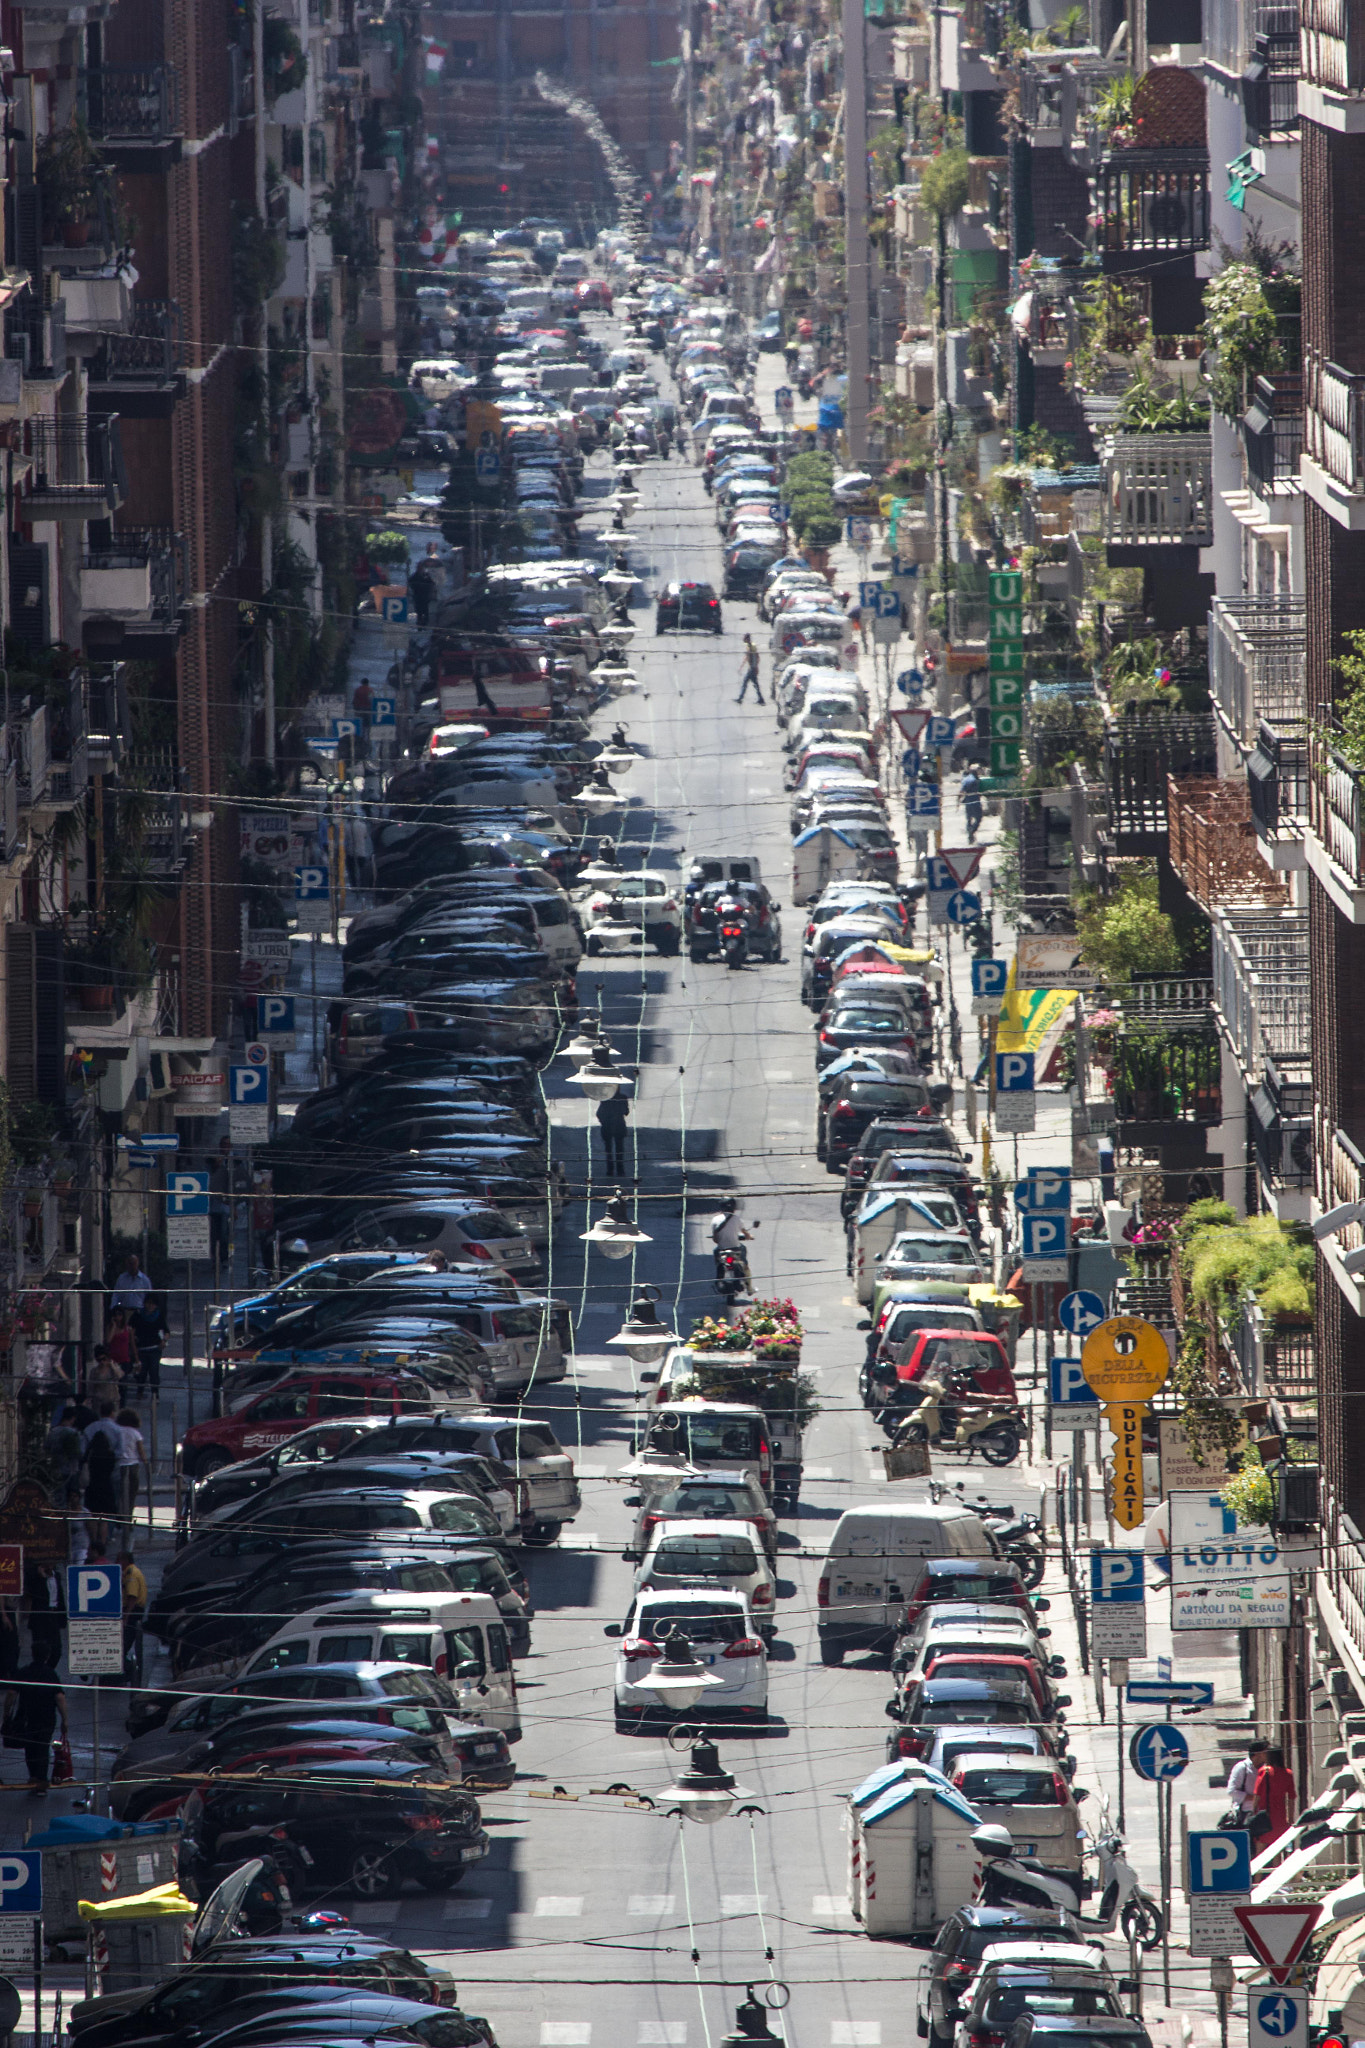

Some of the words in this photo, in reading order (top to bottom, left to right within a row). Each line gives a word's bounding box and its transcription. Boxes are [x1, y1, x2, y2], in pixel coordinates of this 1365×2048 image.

[387, 599, 403, 621] P
[864, 584, 877, 607] P
[878, 593, 896, 615] P
[994, 577, 1019, 771] UNIPOL
[377, 701, 391, 723] P
[932, 719, 950, 742] P
[915, 787, 933, 812] P
[301, 869, 324, 897] P
[259, 944, 289, 956] LIBRI
[978, 964, 1001, 993] P
[264, 998, 287, 1028] P
[235, 1069, 261, 1101] P
[1002, 1055, 1028, 1088] P
[175, 1176, 201, 1211] P
[1035, 1171, 1062, 1206] P
[1031, 1220, 1057, 1254] P
[1088, 1373, 1163, 1385] SICUREZZA
[1103, 1360, 1148, 1372] DELLA
[1060, 1362, 1083, 1401] P
[1123, 1408, 1137, 1522] DUPLICATI
[1183, 1545, 1278, 1567] LOTTO
[78, 1570, 111, 1612] P
[1101, 1555, 1134, 1598] P
[1180, 1604, 1225, 1615] ARTICOLI
[1229, 1603, 1243, 1613] DA
[1247, 1603, 1285, 1613] REGALO
[1200, 1837, 1238, 1887] P
[0, 1857, 29, 1907] P
